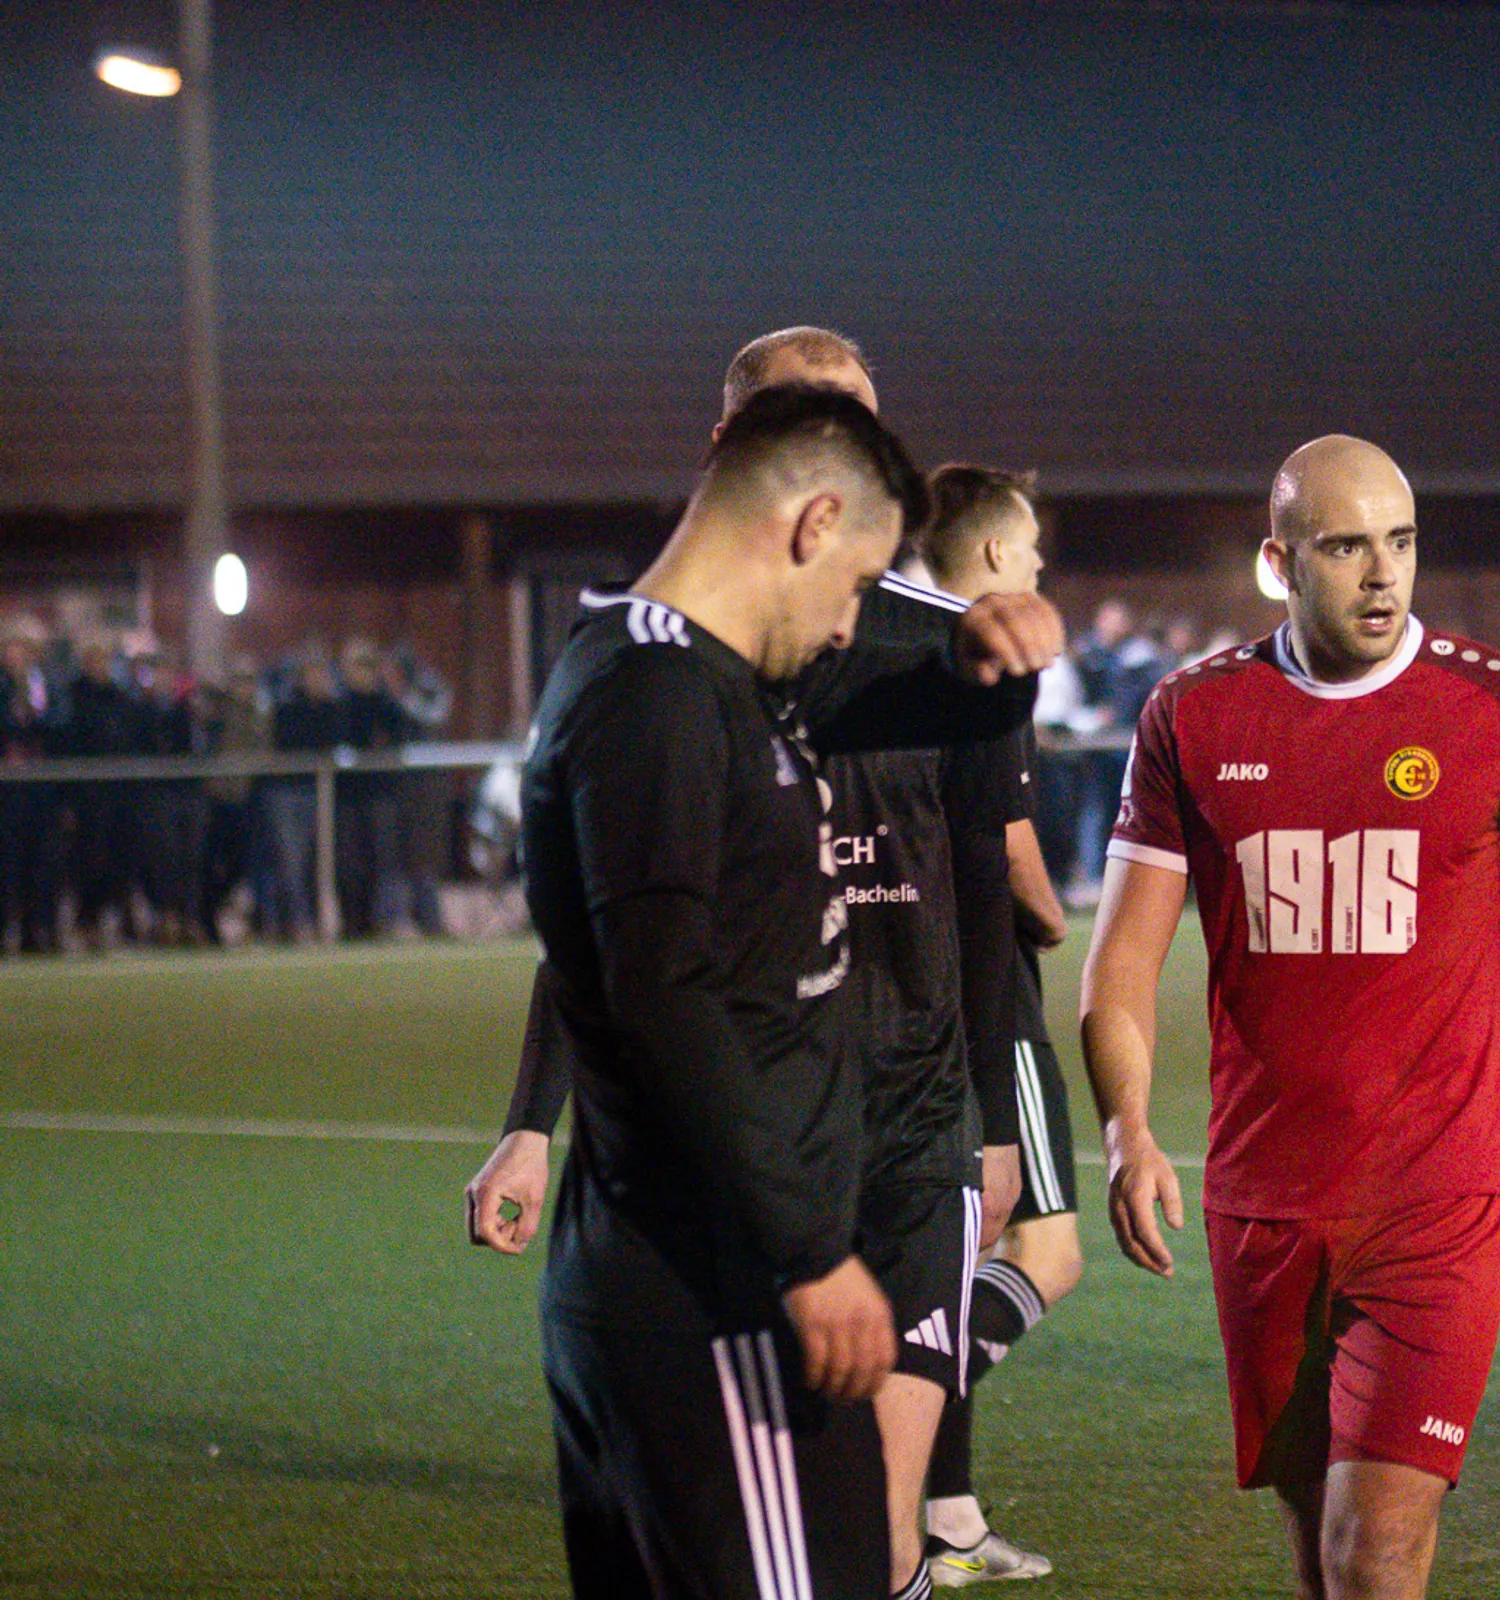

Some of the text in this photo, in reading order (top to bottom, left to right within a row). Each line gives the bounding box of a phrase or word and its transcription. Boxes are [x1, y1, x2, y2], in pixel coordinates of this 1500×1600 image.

[1217, 763, 1269, 781] JAKO
[1235, 829, 1421, 954] 1916
[1420, 1415, 1464, 1446] JAKO
